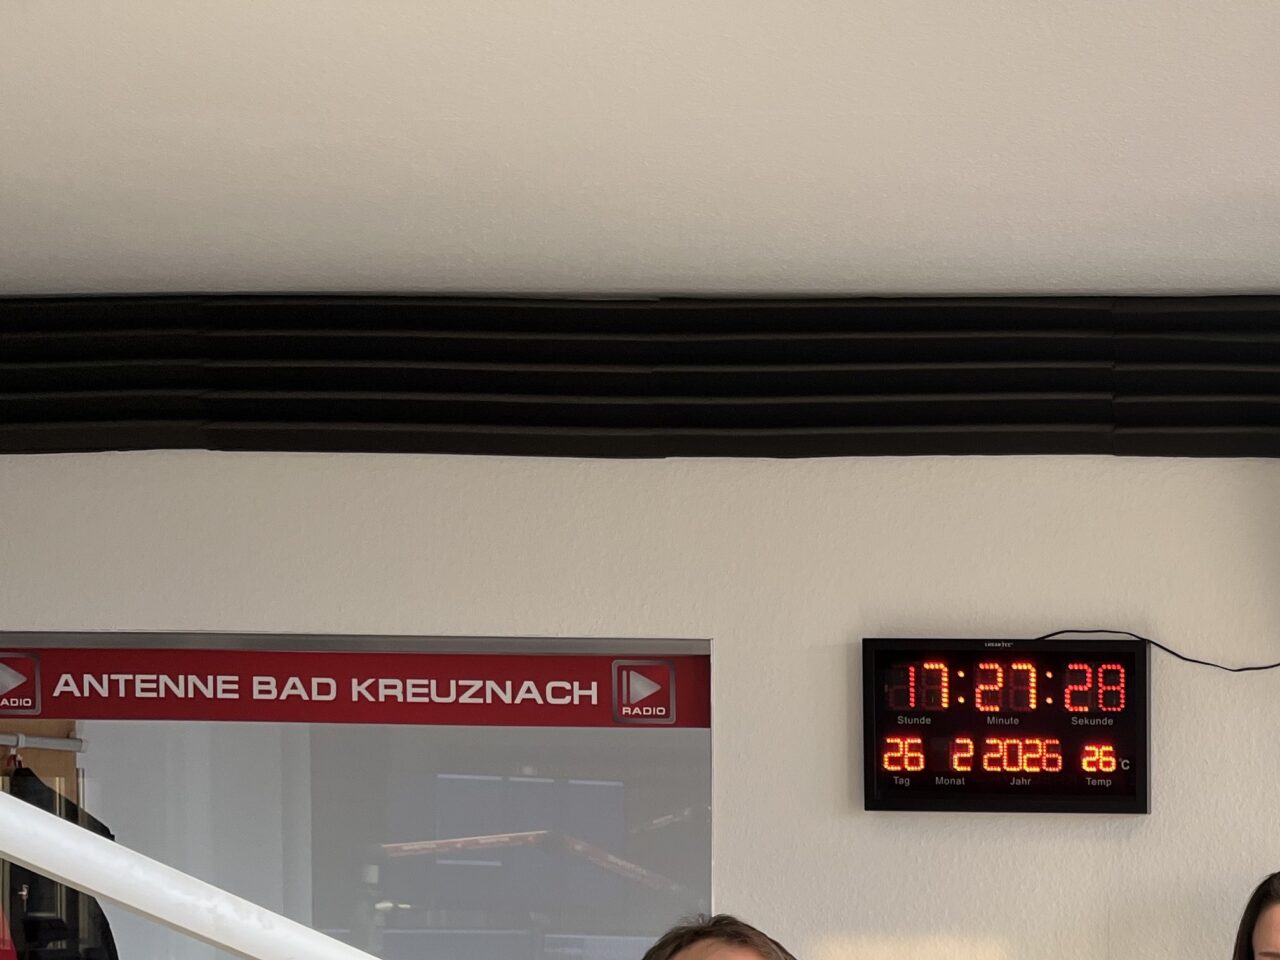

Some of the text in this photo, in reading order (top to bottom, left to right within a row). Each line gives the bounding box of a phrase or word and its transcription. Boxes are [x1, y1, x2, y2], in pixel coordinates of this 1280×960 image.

[53, 673, 598, 705] ANTENNE BAD KREUZNACH
[622, 706, 666, 716] RADIO
[897, 716, 1114, 726] Stunde Minute Sekunde
[883, 738, 1062, 772] 26 2 2026
[1082, 745, 1116, 772] 26
[894, 777, 1112, 787] Tag Monat Jahr Temp
